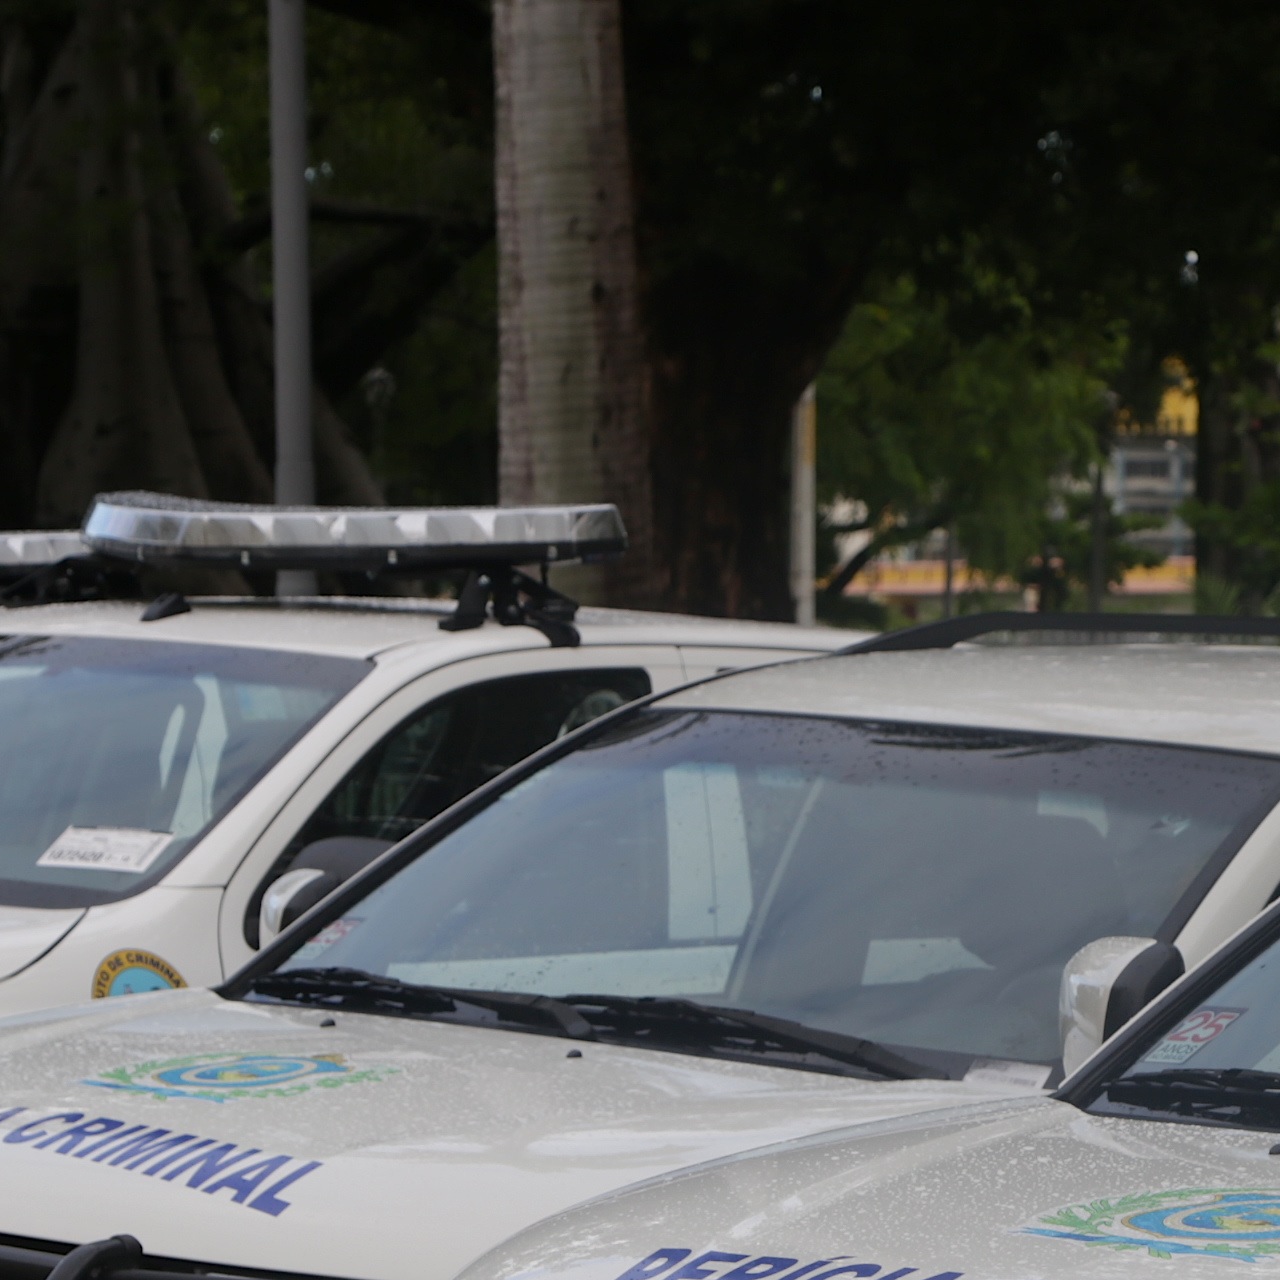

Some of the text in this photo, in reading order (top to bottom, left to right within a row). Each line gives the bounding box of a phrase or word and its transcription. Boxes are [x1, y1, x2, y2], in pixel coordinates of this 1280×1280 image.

[126, 953, 181, 988] CRIMINA
[1167, 1012, 1235, 1042] 25
[2, 1111, 324, 1217] CRIMINAL
